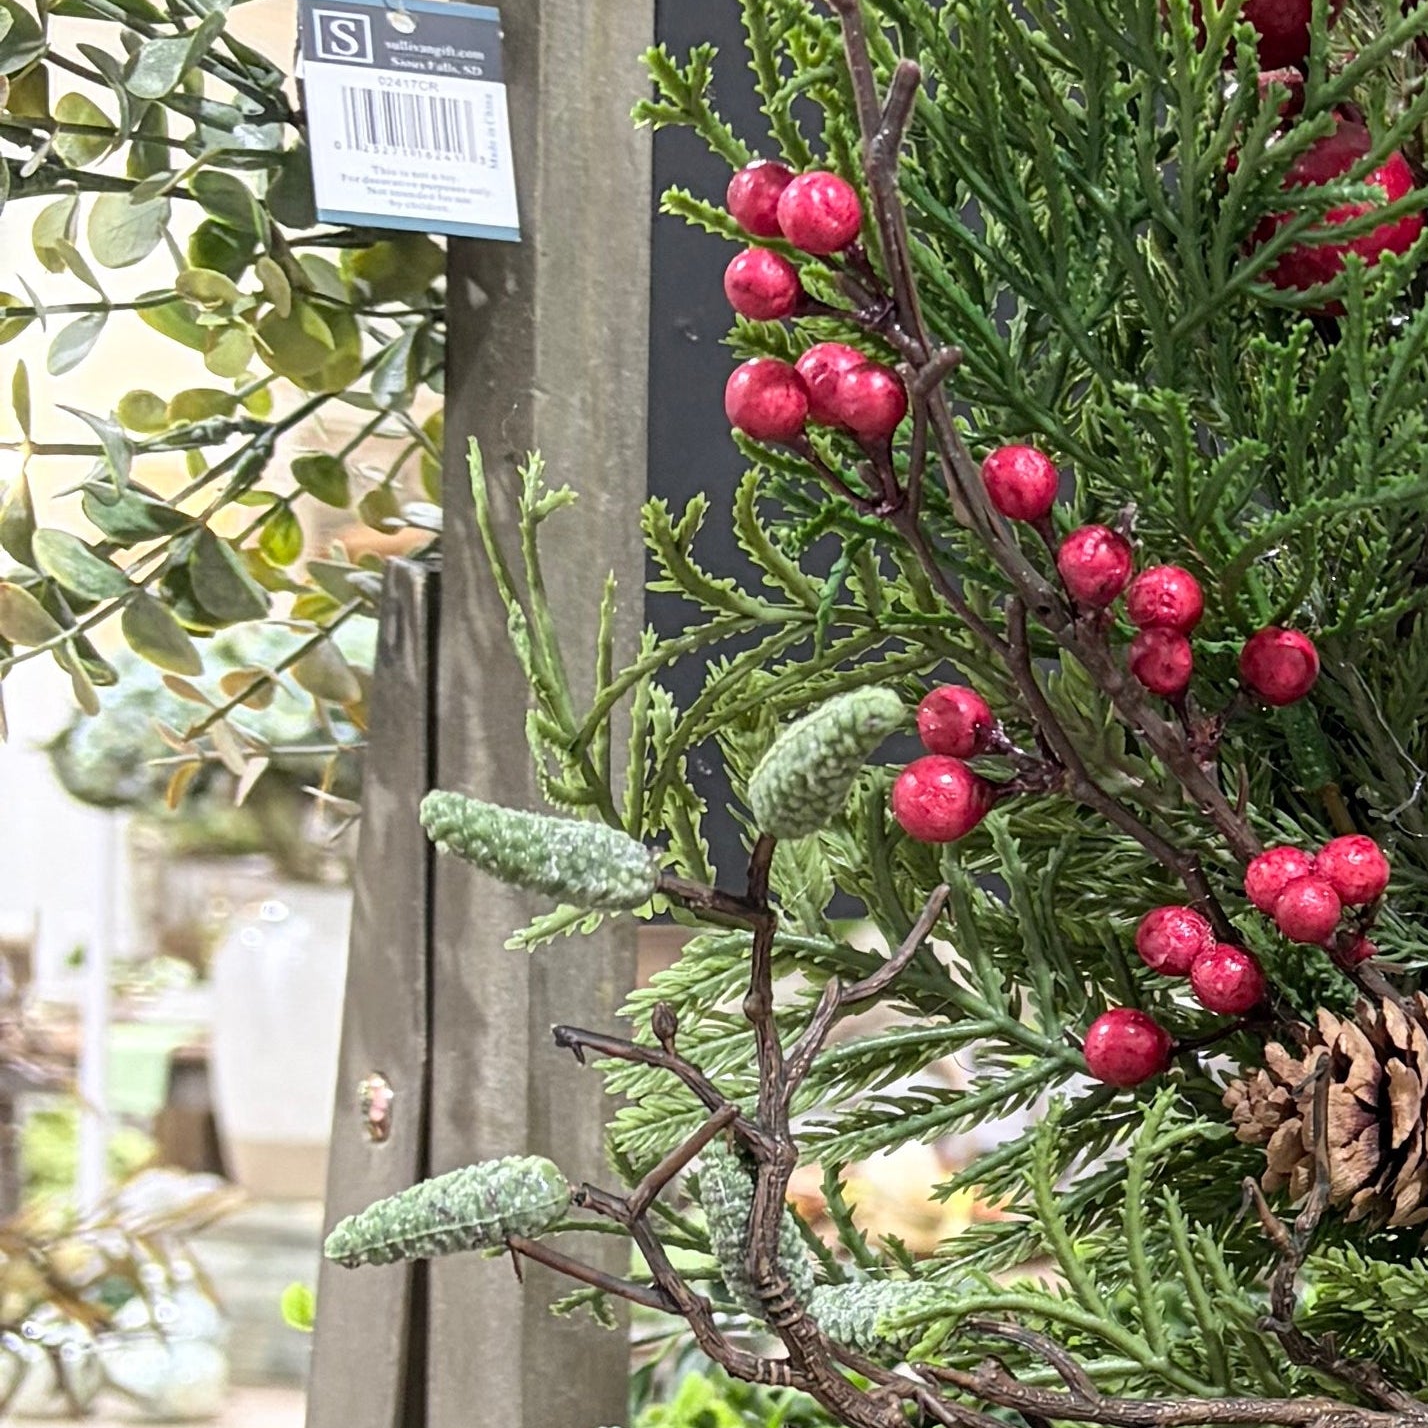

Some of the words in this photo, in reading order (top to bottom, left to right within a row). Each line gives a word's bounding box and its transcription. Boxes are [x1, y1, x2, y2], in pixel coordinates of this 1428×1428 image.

[329, 19, 359, 55] S
[385, 40, 485, 60] sullivangift.com
[462, 64, 483, 76] SD
[377, 75, 439, 93] 02417CR
